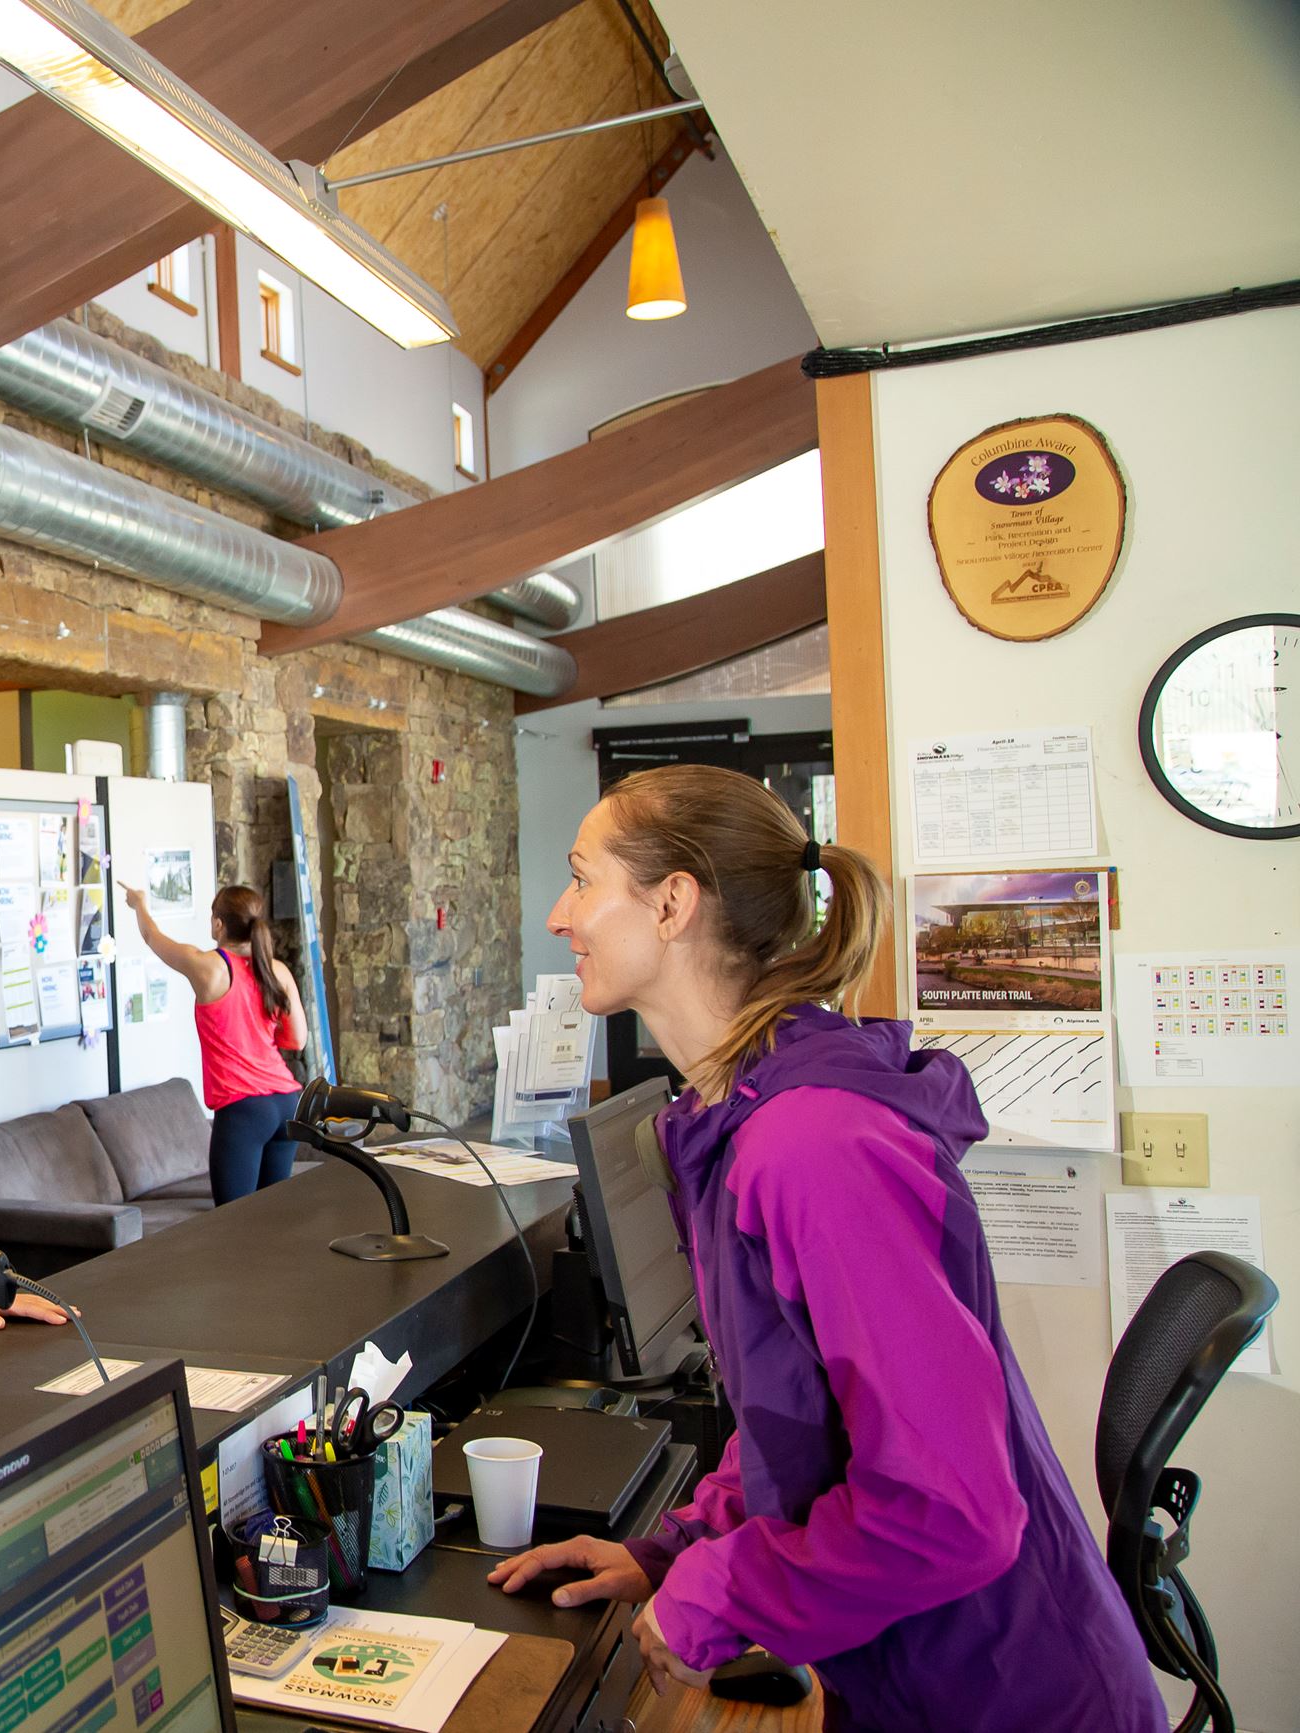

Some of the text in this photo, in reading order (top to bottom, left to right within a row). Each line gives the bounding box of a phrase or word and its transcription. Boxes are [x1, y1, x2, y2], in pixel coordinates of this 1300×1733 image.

[970, 436, 1077, 467] Columbine Award
[1010, 506, 1044, 518] Town of
[990, 515, 1064, 530] Snowmass Village
[1008, 528, 1053, 540] Recreation
[1054, 525, 1072, 534] and
[998, 537, 1059, 549] Project Design
[1031, 582, 1063, 593] CPRA
[922, 990, 1033, 1001] SOUTH PLATTE RIVER TRAIL
[284, 1683, 394, 1707] SNOWMASS
[288, 1677, 399, 1700] RENDEZVOUS
